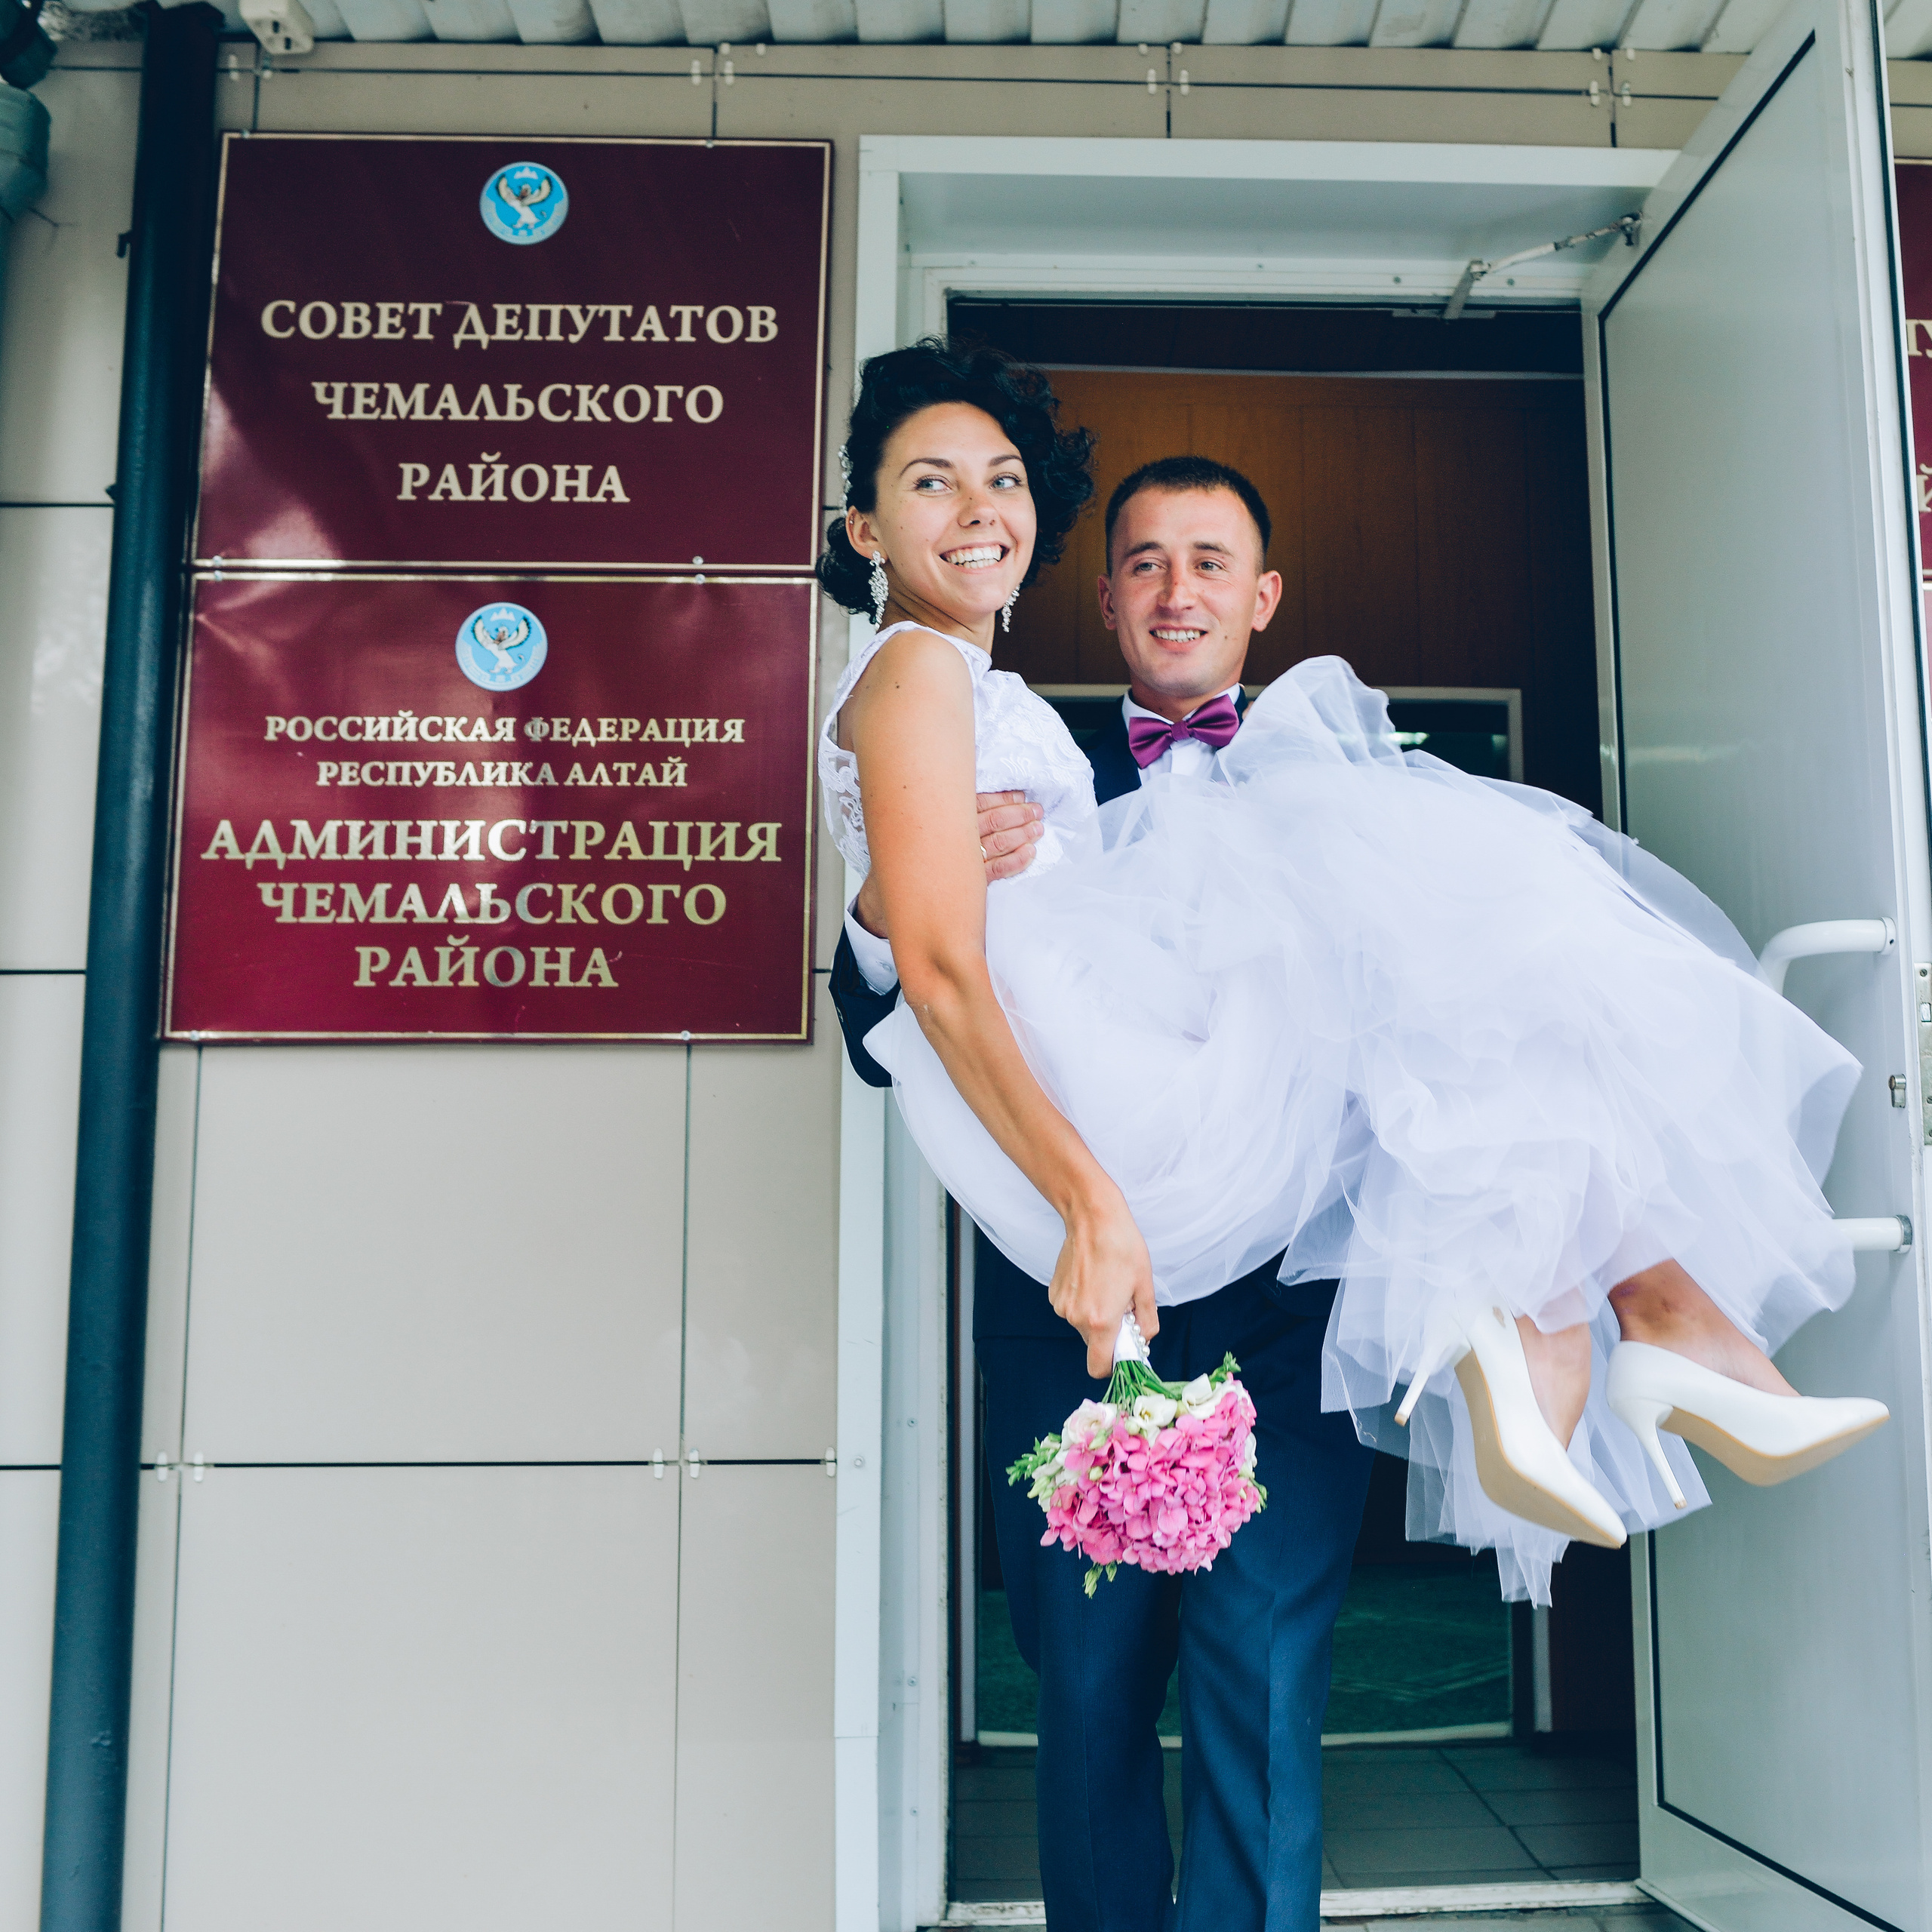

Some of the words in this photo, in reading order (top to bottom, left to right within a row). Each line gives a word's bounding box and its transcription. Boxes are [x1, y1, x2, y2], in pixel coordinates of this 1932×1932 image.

[261, 300, 442, 340] СОВЕТ
[453, 303, 779, 349] ДЕПУТАТОВ
[312, 383, 724, 423] ЧЕМАЛЬСКОГО
[397, 452, 631, 503] РАЙОНА
[264, 710, 515, 743] РОССИЙСКАЯ
[524, 715, 746, 747] ФЕДЕРАЦИЯ
[316, 760, 558, 787] РЕСПУБЛИКА
[564, 756, 688, 787] АЛТАЙ
[200, 819, 782, 871] АДМИНИСТРАЦИЯ
[257, 882, 727, 925] ЧЕМАЛЬСКОГО
[354, 935, 619, 988] РАЙОНА
